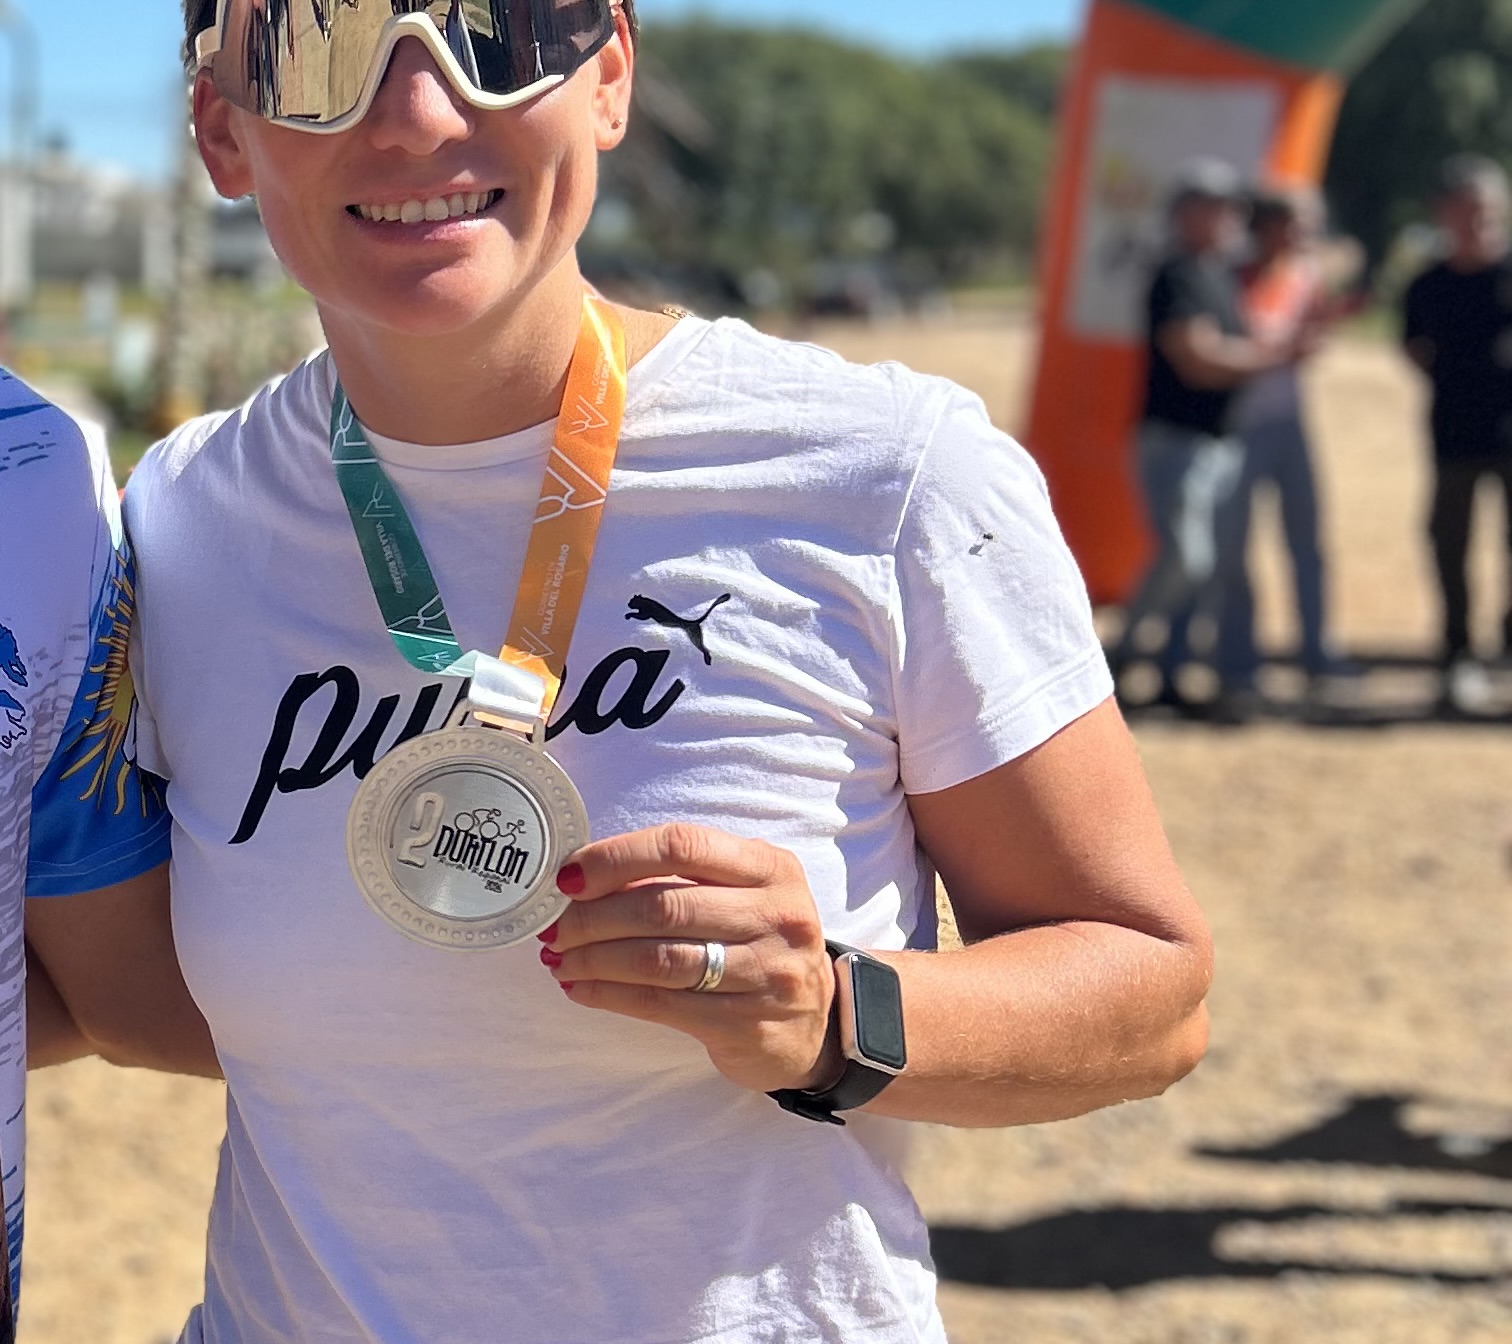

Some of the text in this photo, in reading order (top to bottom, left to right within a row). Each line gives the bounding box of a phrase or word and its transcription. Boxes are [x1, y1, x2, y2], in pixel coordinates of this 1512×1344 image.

[375, 520, 390, 546] VILLA
[541, 543, 570, 635] VILLA DEL ROSARIO
[228, 646, 687, 845] pua
[397, 791, 444, 869] 2
